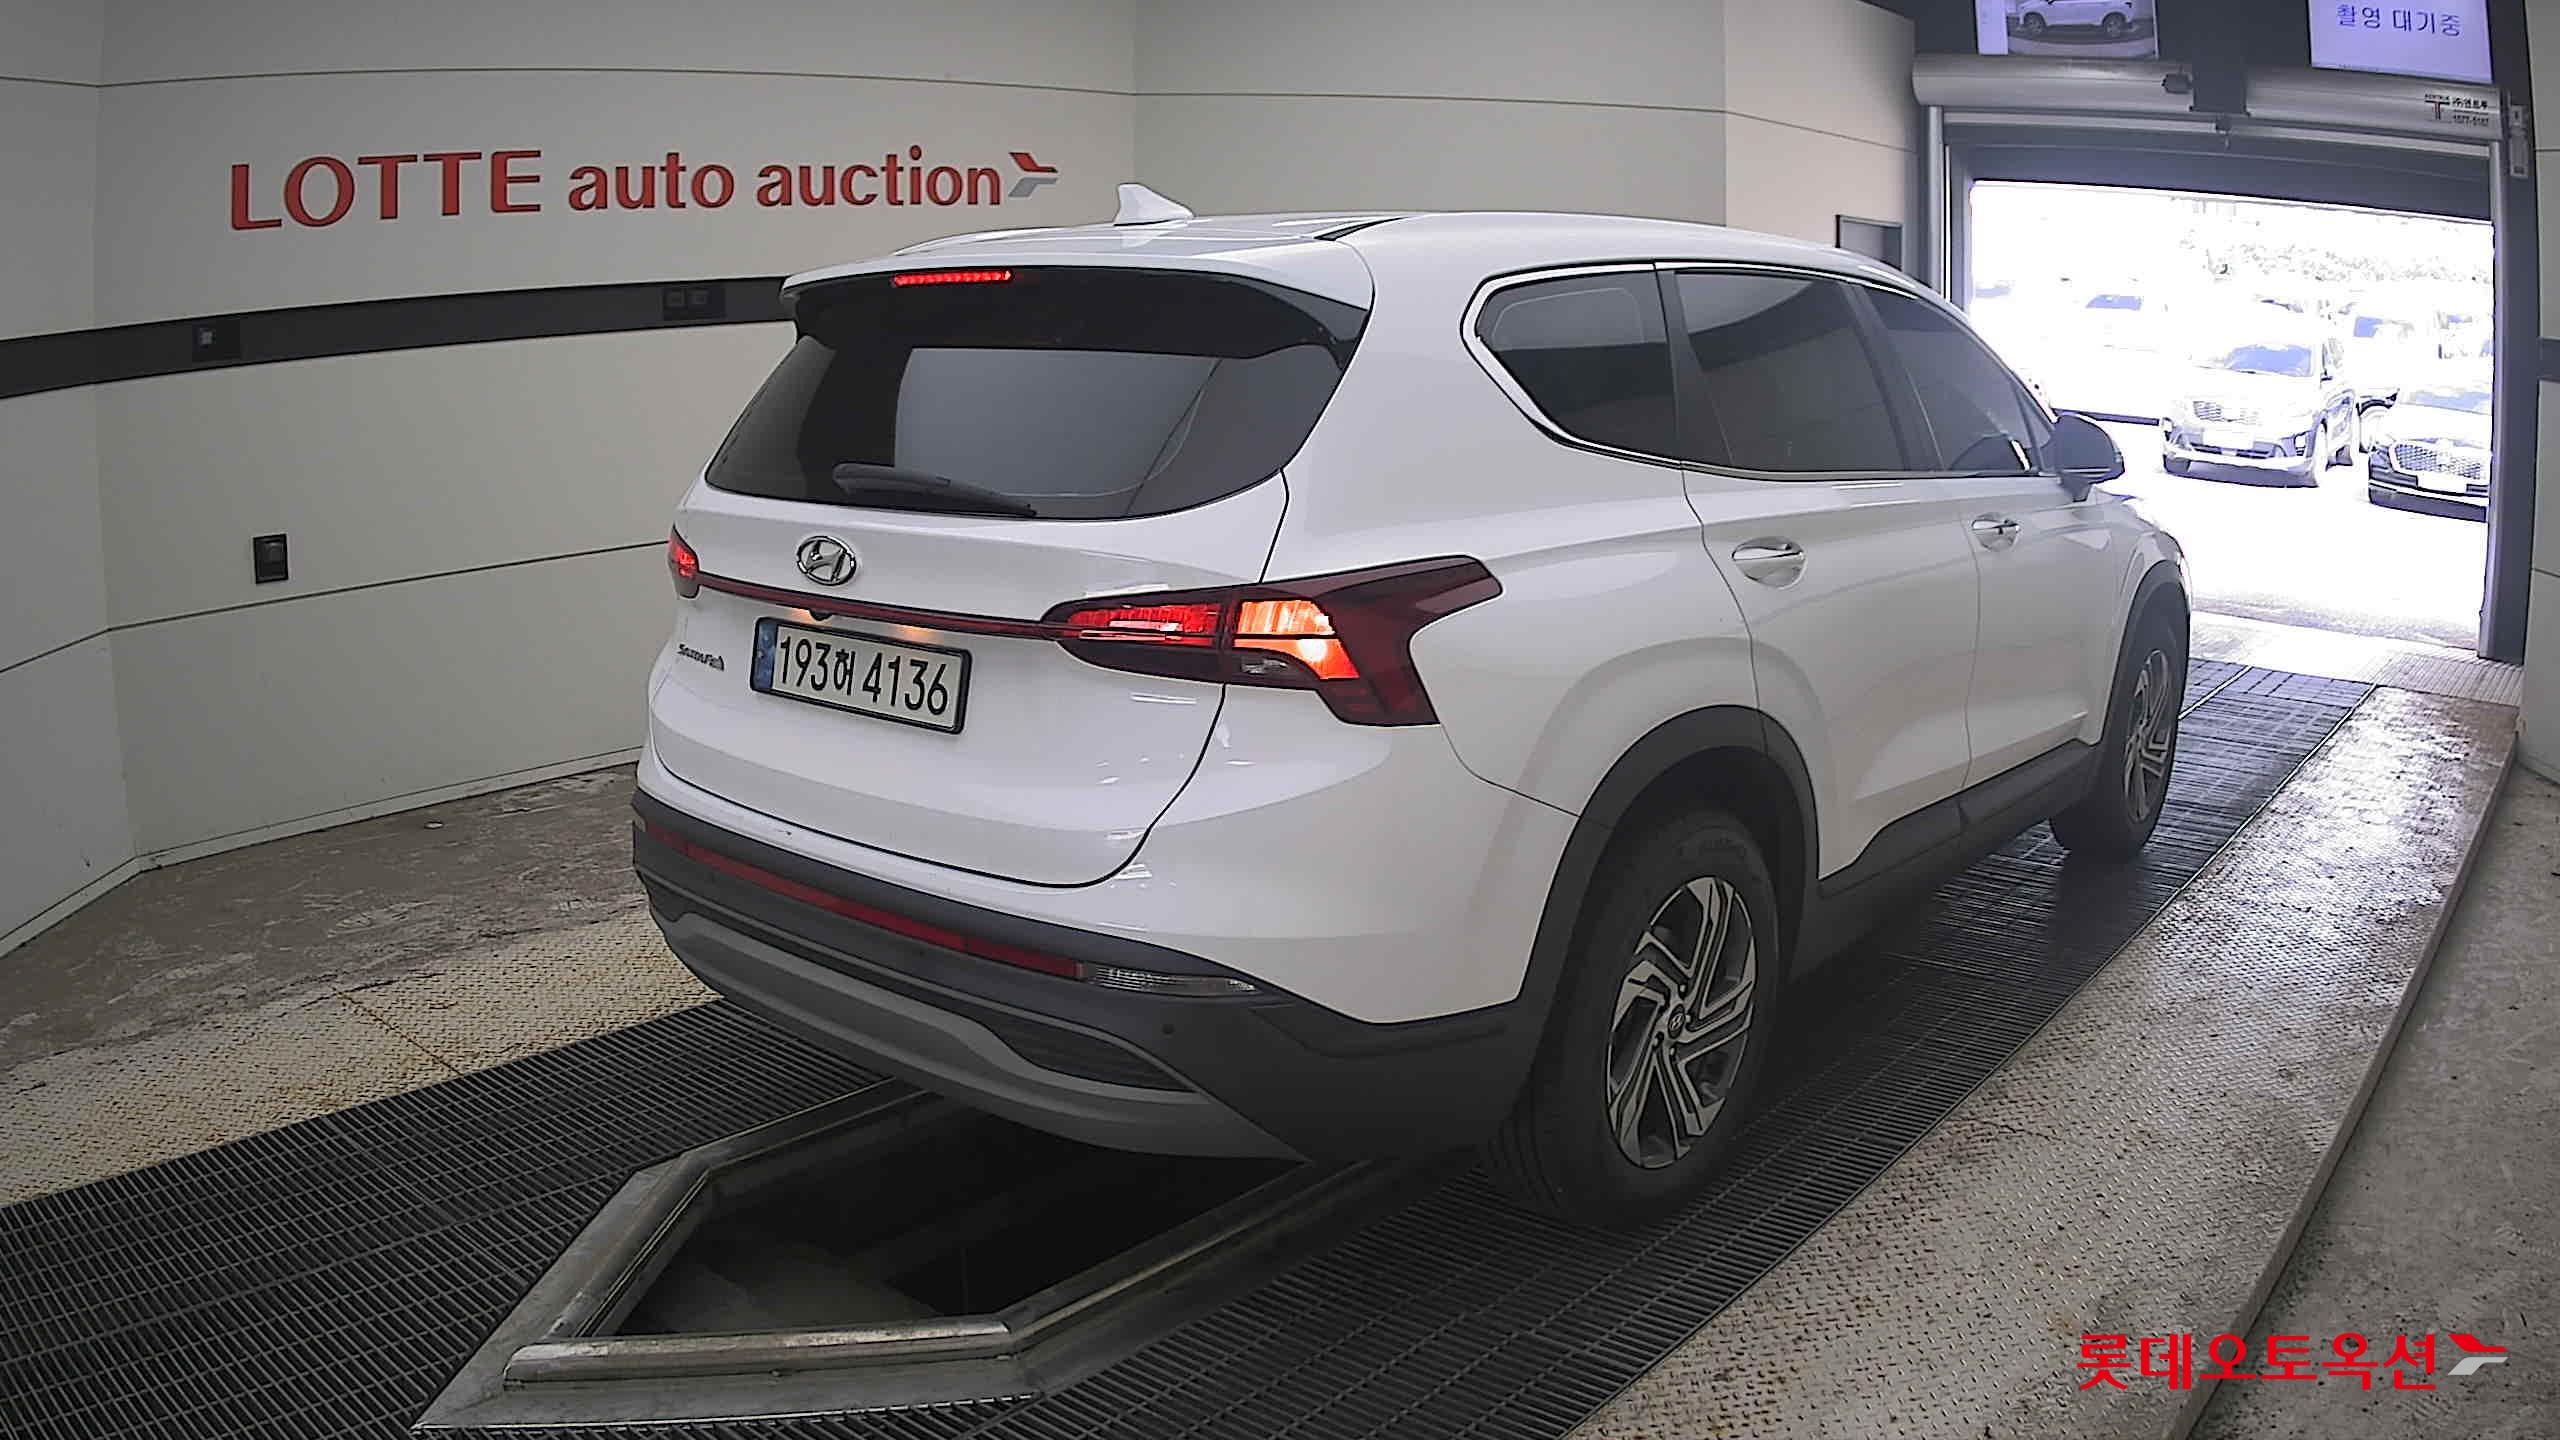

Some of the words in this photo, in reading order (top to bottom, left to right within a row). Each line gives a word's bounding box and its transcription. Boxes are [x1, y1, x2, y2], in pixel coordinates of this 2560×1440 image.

[2336, 4, 2381, 29] 촬영
[2392, 8, 2461, 37] 대기중
[231, 150, 542, 232] LOTTE
[567, 153, 735, 211] auto
[756, 145, 1002, 208] auction
[862, 651, 949, 716] 4136
